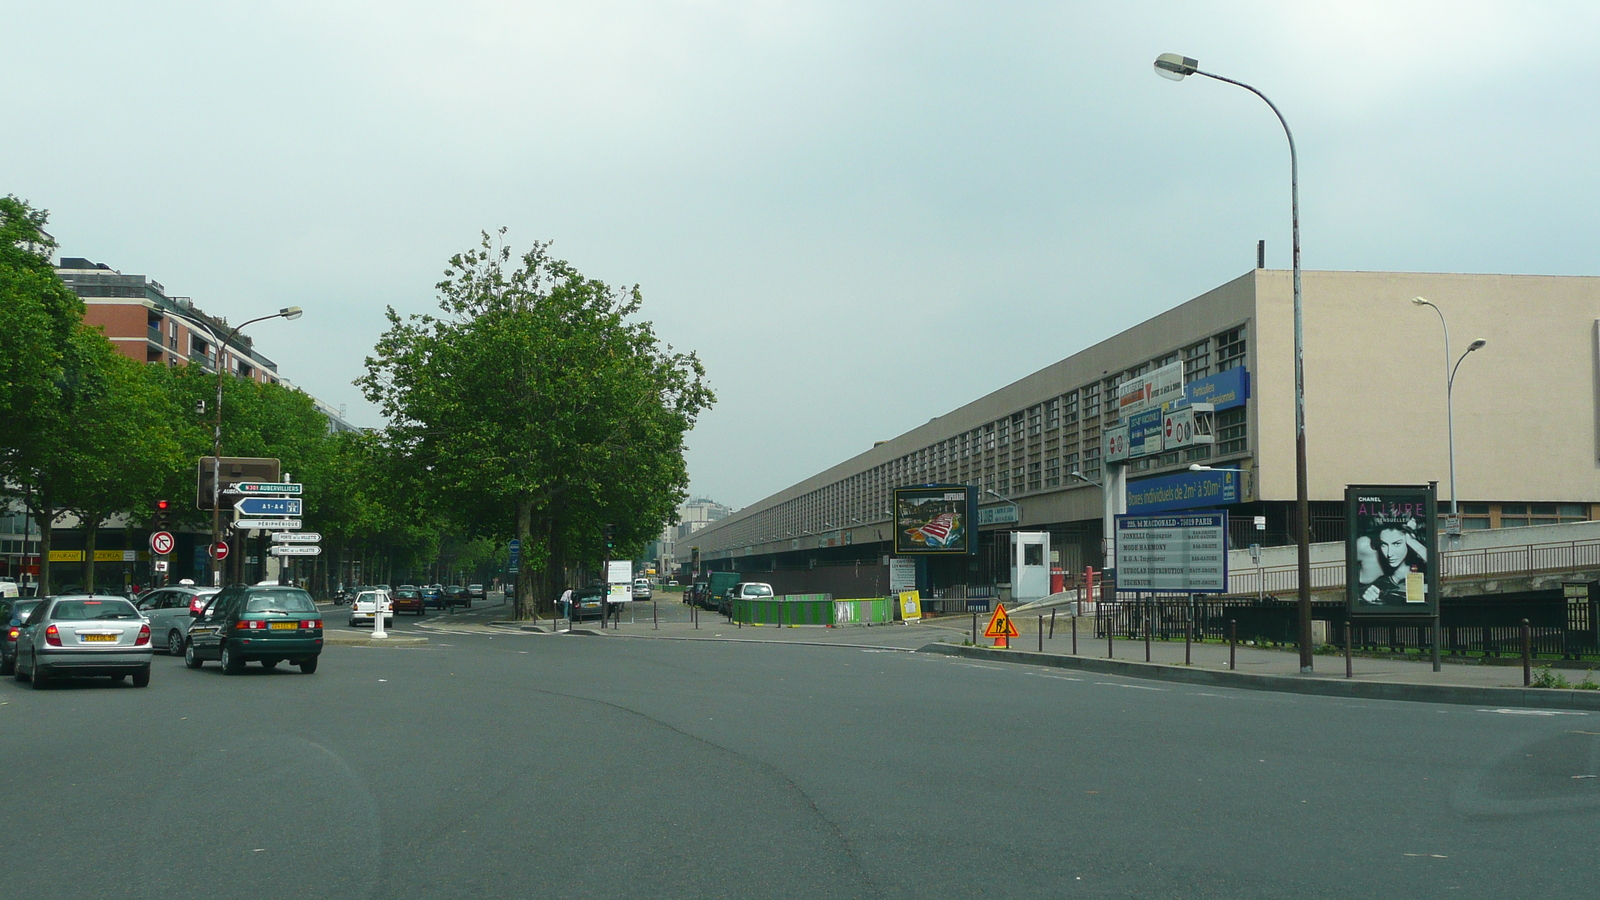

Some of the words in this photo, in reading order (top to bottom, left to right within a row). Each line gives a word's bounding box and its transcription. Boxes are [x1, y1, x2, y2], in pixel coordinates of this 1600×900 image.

[1193, 383, 1215, 398] Particuliers
[1128, 491, 1143, 506] Boxes
[1143, 485, 1174, 503] individuels
[1174, 486, 1183, 500] de
[1197, 485, 1202, 497] à
[1358, 503, 1424, 516] ALLURE
[1143, 519, 1176, 527] MACDONALD
[1195, 517, 1213, 525] PARIS
